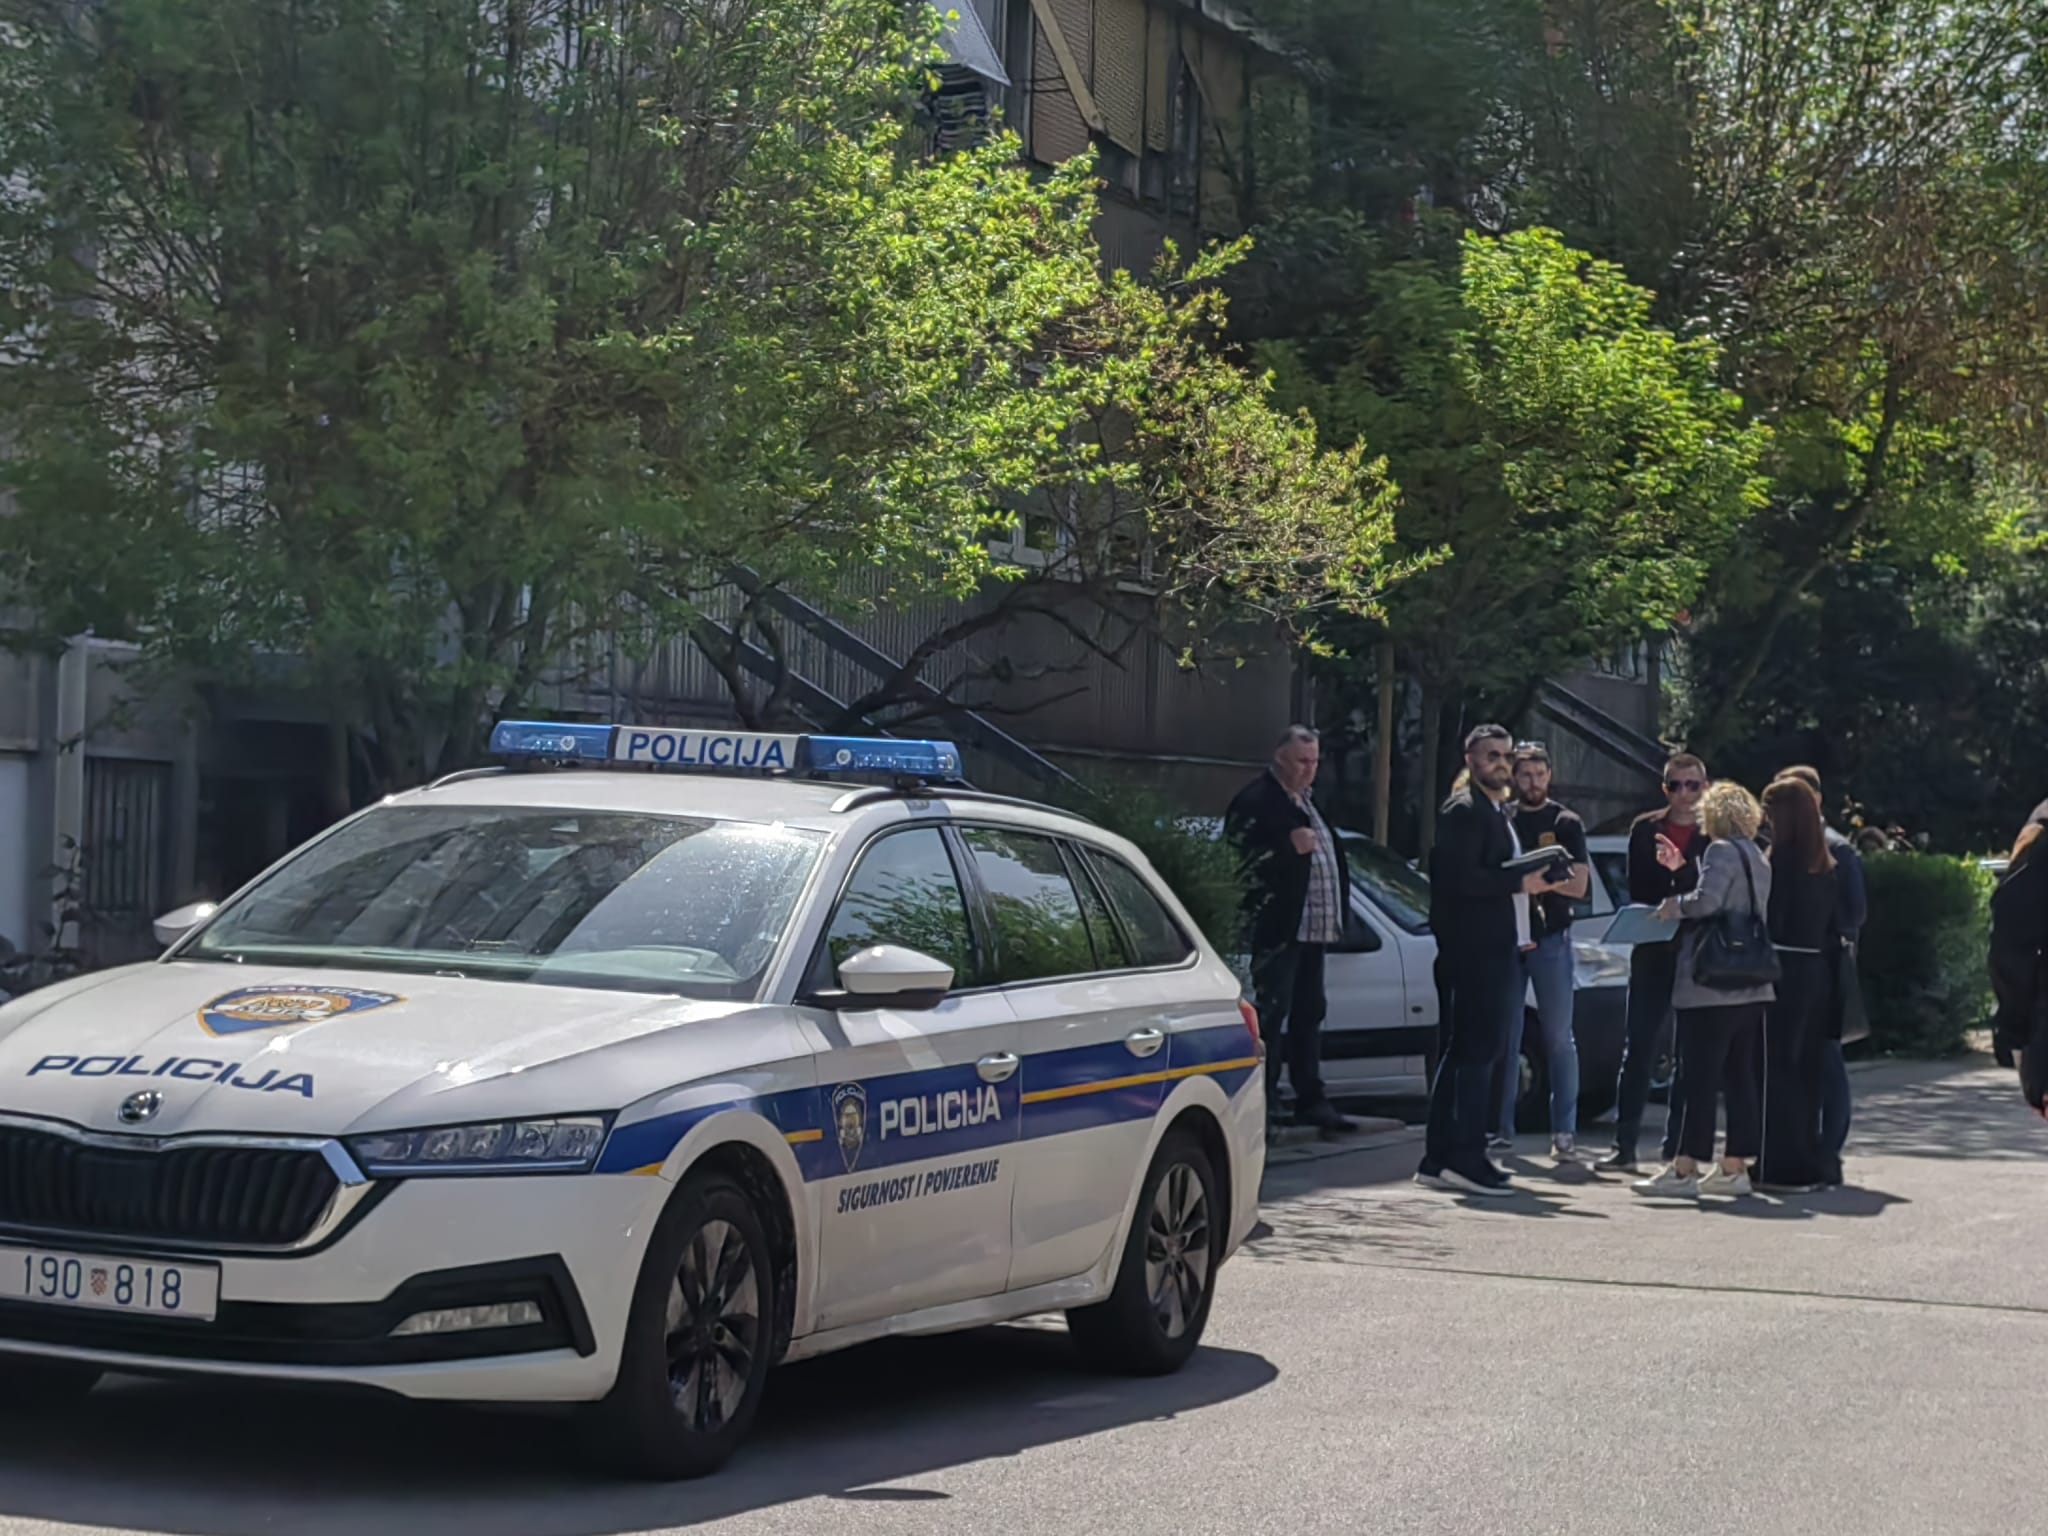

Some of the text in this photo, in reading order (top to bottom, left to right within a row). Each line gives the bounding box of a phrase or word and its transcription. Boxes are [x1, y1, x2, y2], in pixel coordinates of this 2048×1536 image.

[628, 733, 785, 767] POLICIJA
[26, 1055, 315, 1099] POLICIJA
[881, 1085, 1001, 1140] POLICIJA
[837, 1159, 1000, 1214] SIGURNOST I POVJERENJE
[25, 1255, 181, 1309] 190 818
